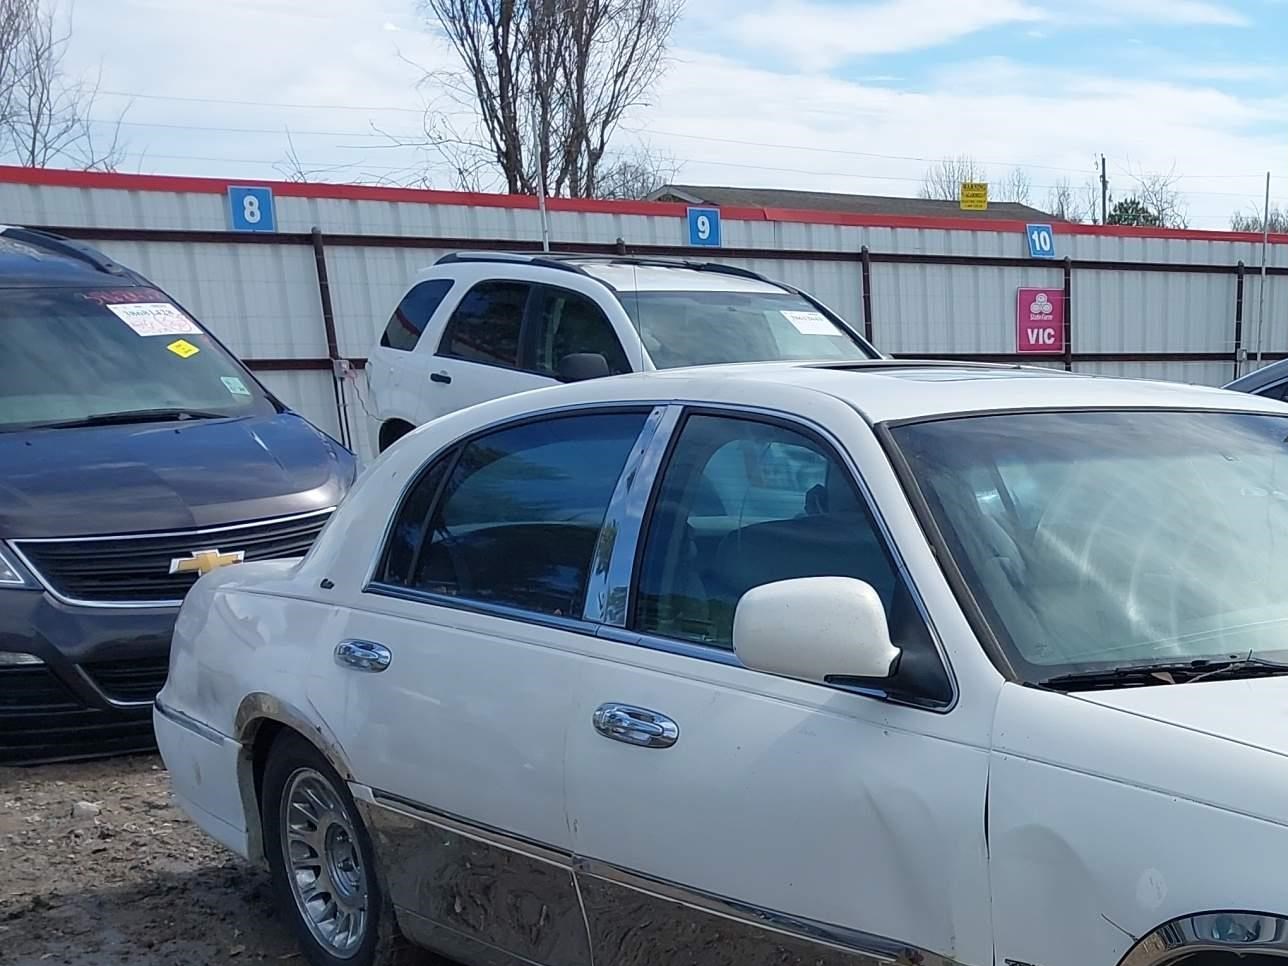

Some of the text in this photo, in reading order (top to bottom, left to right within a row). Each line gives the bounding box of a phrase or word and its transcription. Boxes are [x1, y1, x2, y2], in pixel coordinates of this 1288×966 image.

[243, 195, 261, 224] 8
[697, 215, 710, 240] 9
[1032, 230, 1051, 251] 10
[1027, 328, 1056, 345] VIC
